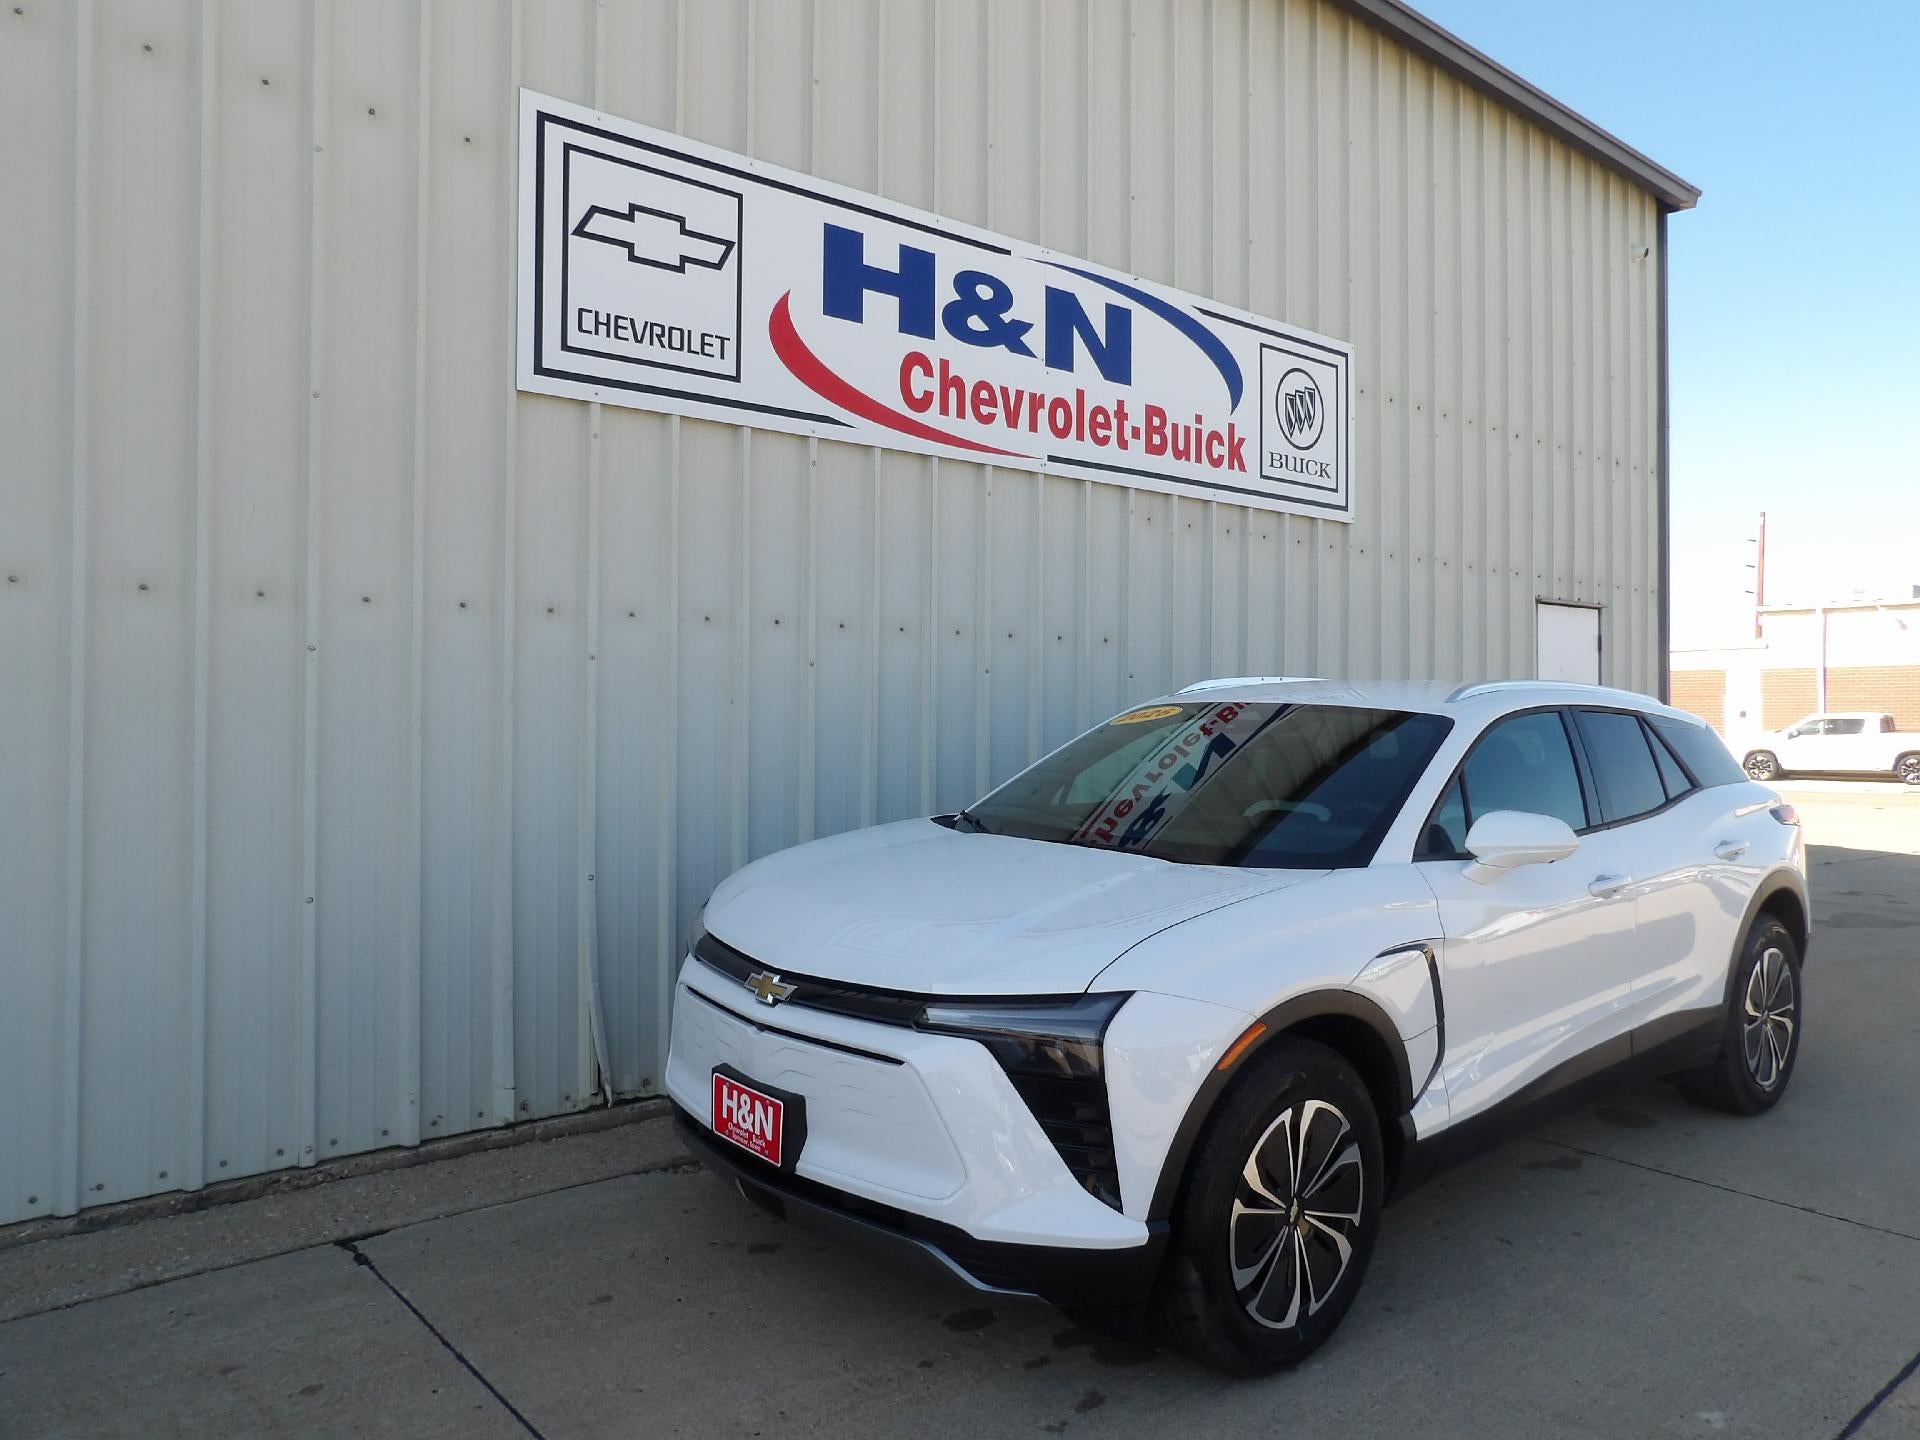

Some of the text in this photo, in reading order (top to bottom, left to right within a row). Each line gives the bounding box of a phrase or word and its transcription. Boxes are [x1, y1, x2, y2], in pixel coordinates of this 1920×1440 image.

[823, 222, 1132, 387] H&N
[577, 307, 732, 363] CHEVROLET
[899, 350, 1248, 474] Chevrolet-Buick
[1267, 451, 1332, 481] BUICK
[723, 1084, 774, 1141] H&N
